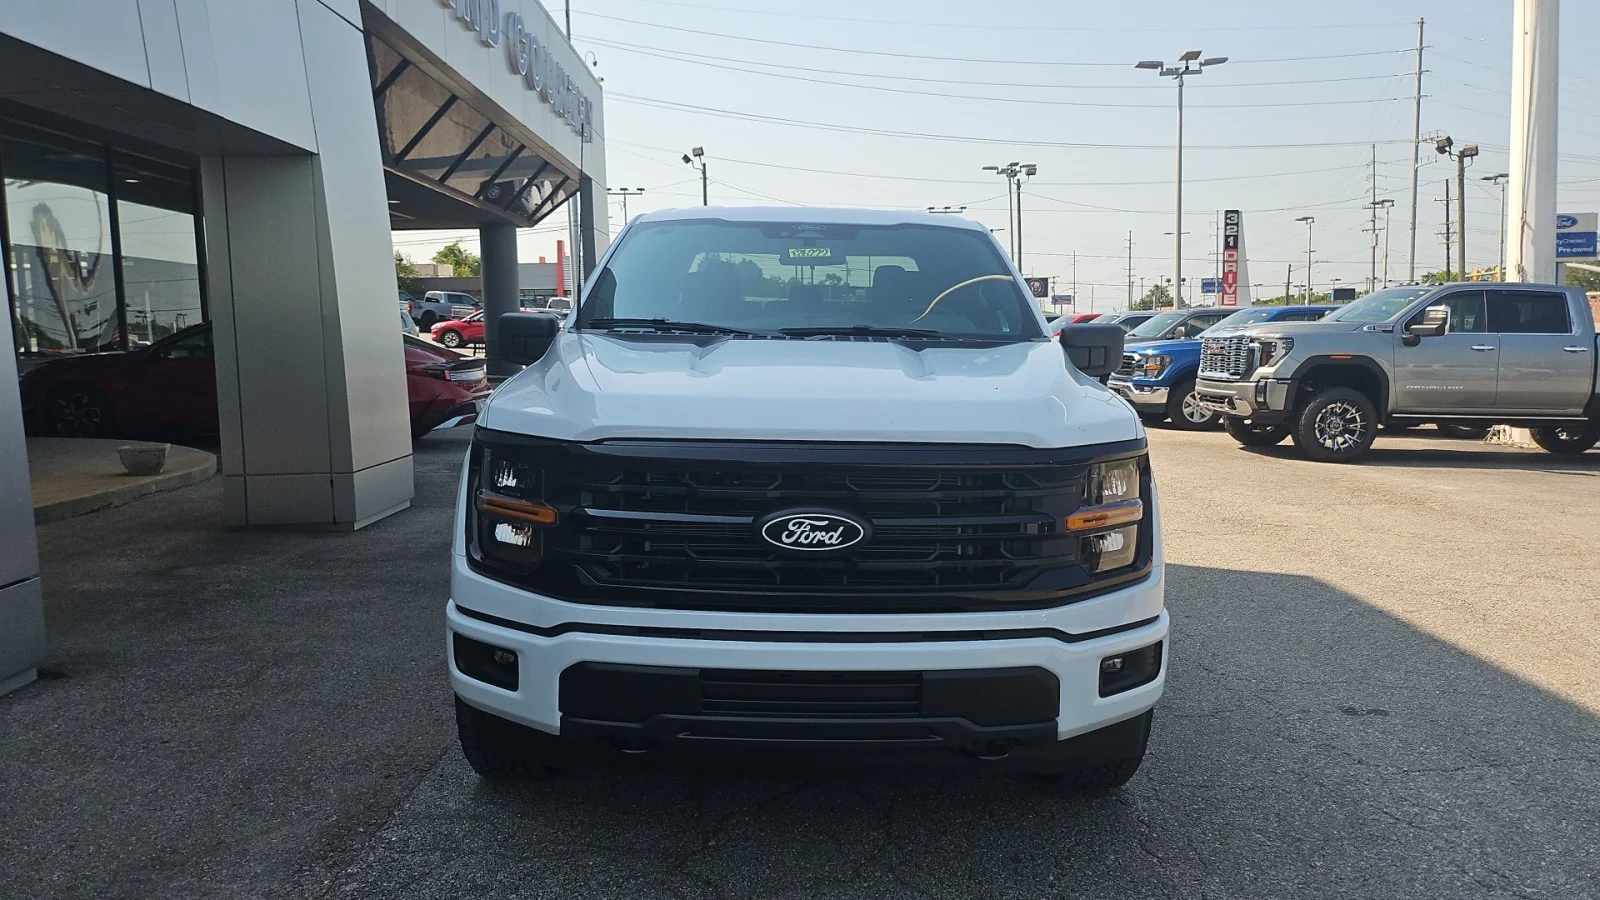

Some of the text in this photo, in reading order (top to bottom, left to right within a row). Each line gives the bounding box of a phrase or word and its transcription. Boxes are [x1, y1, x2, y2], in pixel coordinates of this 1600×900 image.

[1223, 213, 1238, 305] 321 DRIVE
[781, 518, 844, 544] Ford
